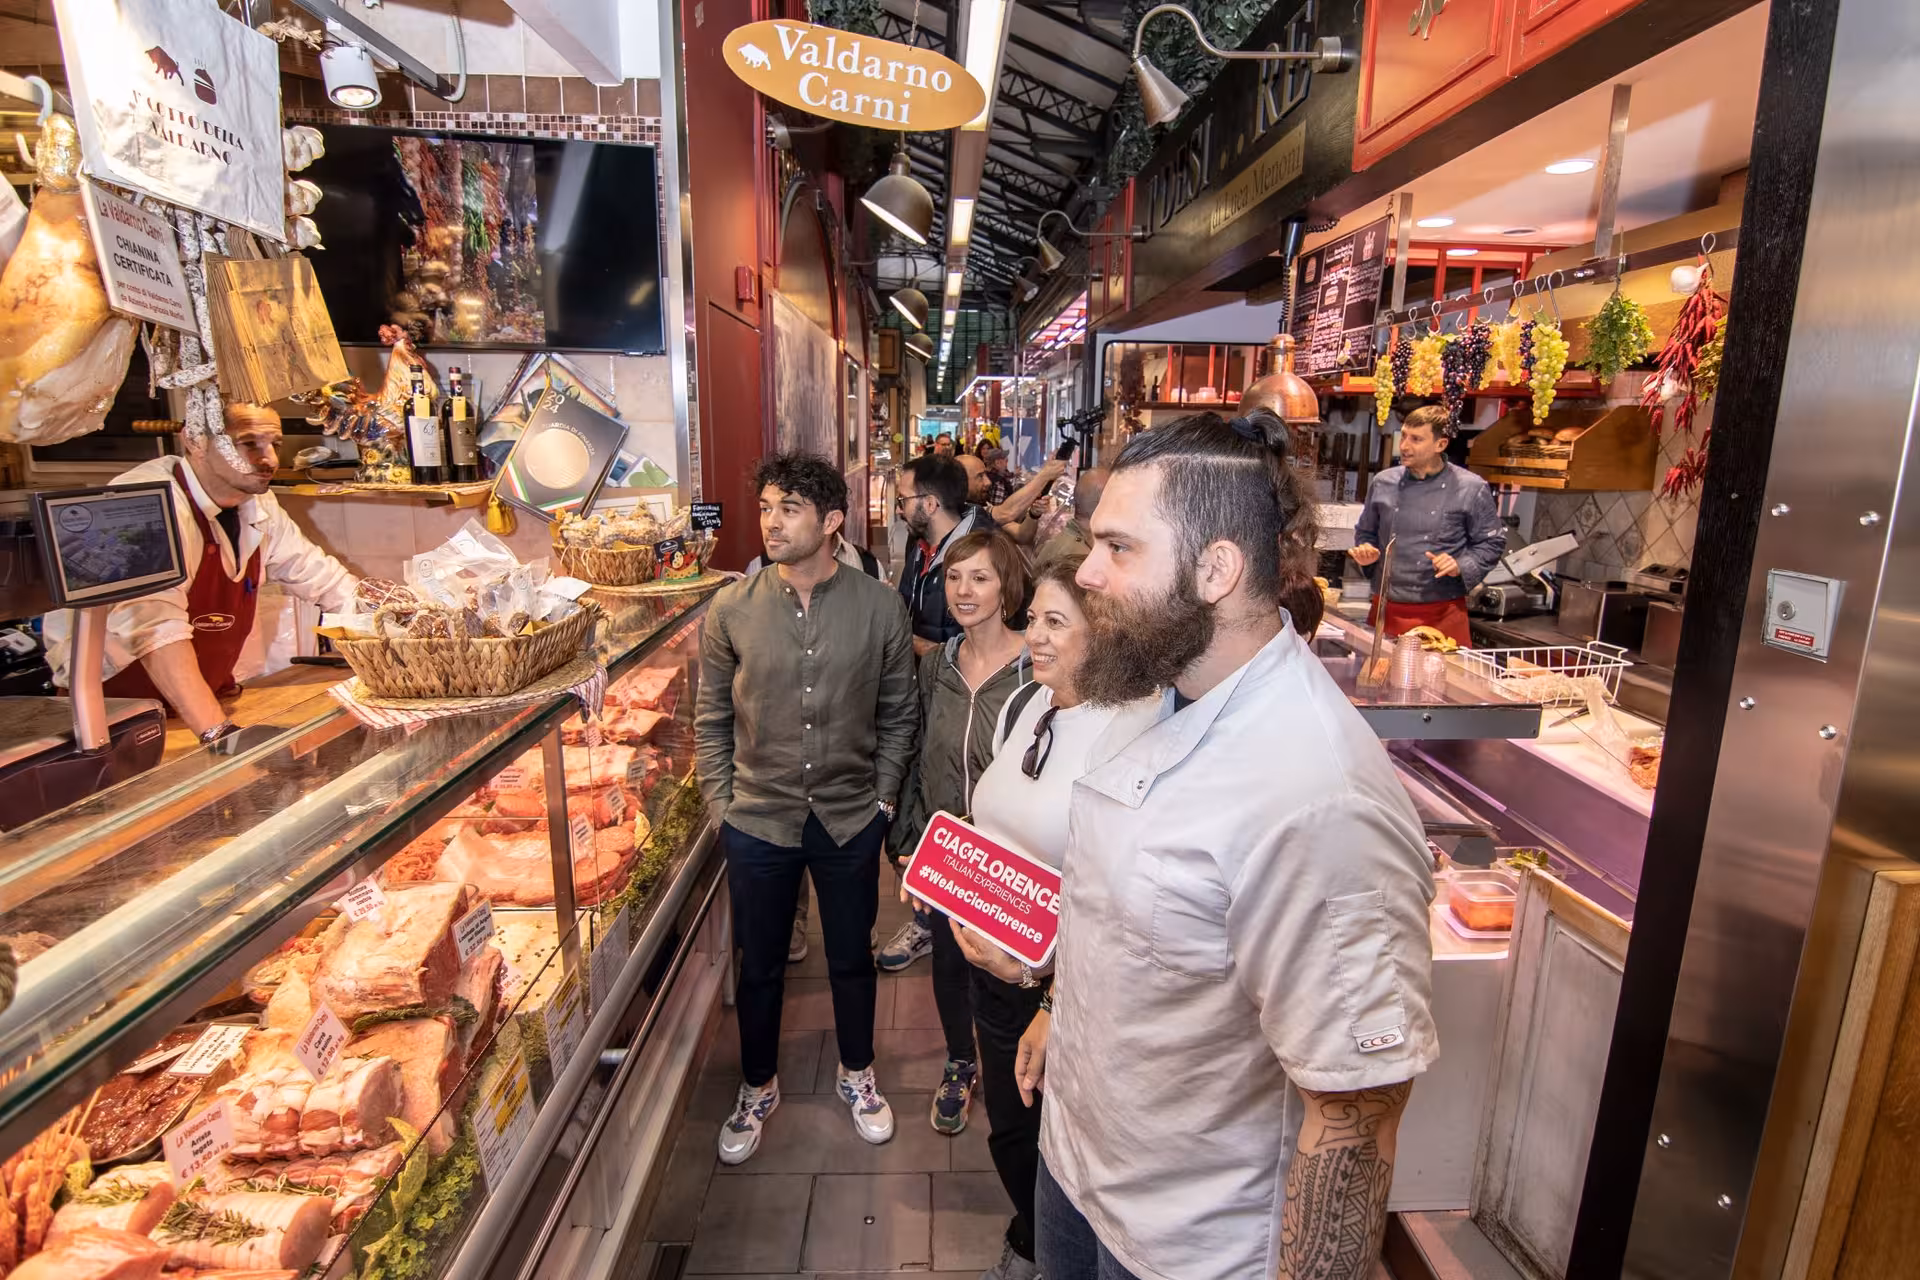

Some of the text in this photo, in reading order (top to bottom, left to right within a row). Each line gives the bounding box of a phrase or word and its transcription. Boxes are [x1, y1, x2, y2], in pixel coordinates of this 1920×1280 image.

[774, 24, 952, 92] Valdarno
[799, 71, 911, 124] Carni
[202, 120, 244, 151] DELLA
[96, 196, 108, 217] La
[107, 199, 141, 231] Valdarno
[116, 235, 159, 263] CHIANINA
[114, 252, 172, 287] CERTIFICATA
[541, 400, 560, 414] 24
[547, 391, 565, 405] 20
[943, 854, 1032, 915] ITALIAN EXPERIENCES
[919, 865, 1043, 944] #WeAreCiaoFlorence
[175, 1135, 183, 1147] La
[183, 1117, 206, 1138] Valdarno
[191, 1129, 210, 1146] Arista
[193, 1137, 212, 1157] legata
[181, 1168, 187, 1179] €
[220, 1140, 228, 1150] kg
